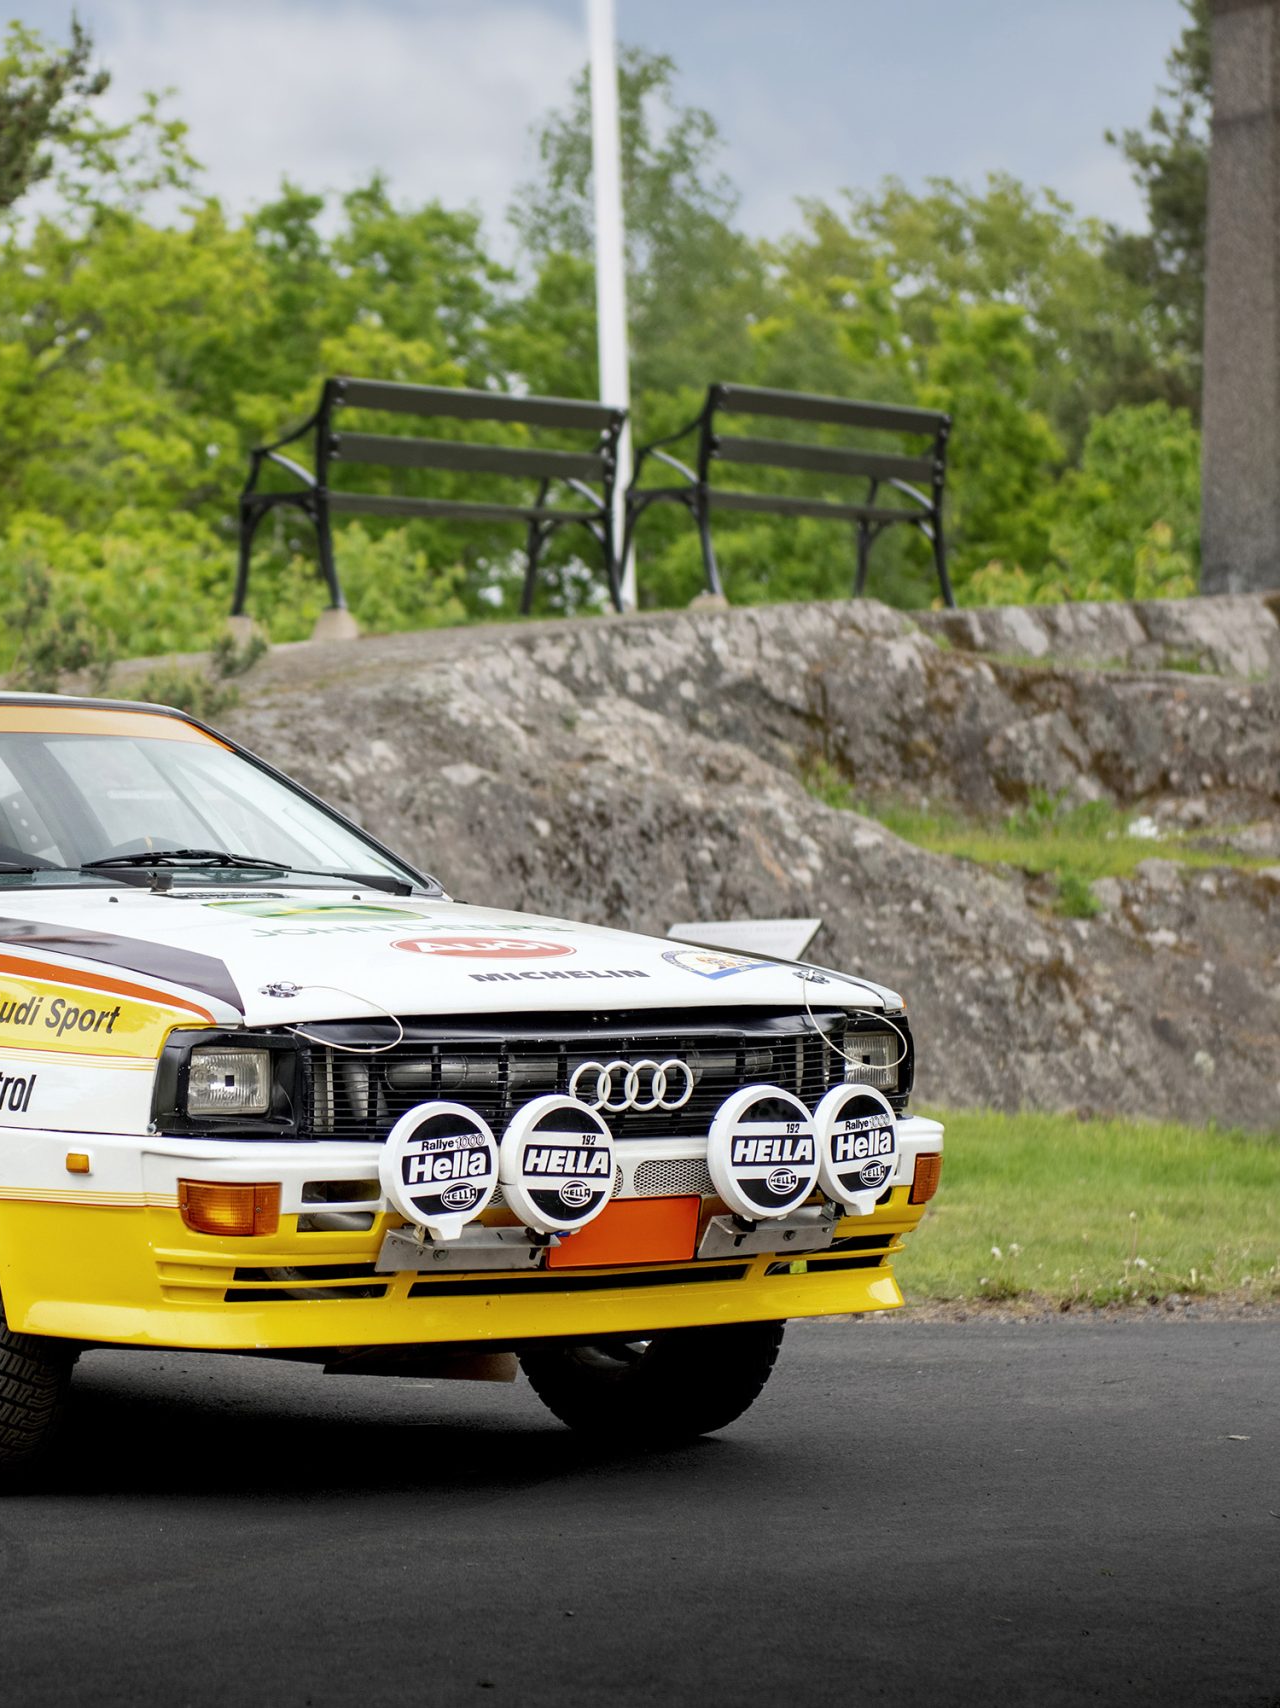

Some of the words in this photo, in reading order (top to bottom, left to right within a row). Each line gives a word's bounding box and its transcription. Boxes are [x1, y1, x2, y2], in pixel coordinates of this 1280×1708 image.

[468, 969, 652, 982] MICHELIN
[45, 998, 121, 1037] Sport
[786, 1123, 800, 1133] 192
[845, 1119, 869, 1131] Rallye
[421, 1140, 454, 1152] Rallye
[455, 1133, 486, 1149] 1000
[581, 1134, 596, 1146] 192
[836, 1129, 891, 1161] Hella
[733, 1138, 813, 1162] HELLA
[409, 1151, 486, 1183] Hella
[525, 1149, 609, 1174] HELLA
[862, 1165, 886, 1178] HELLA
[770, 1174, 796, 1185] HELLA
[443, 1186, 478, 1201] HELLA
[563, 1185, 591, 1198] HELLA
